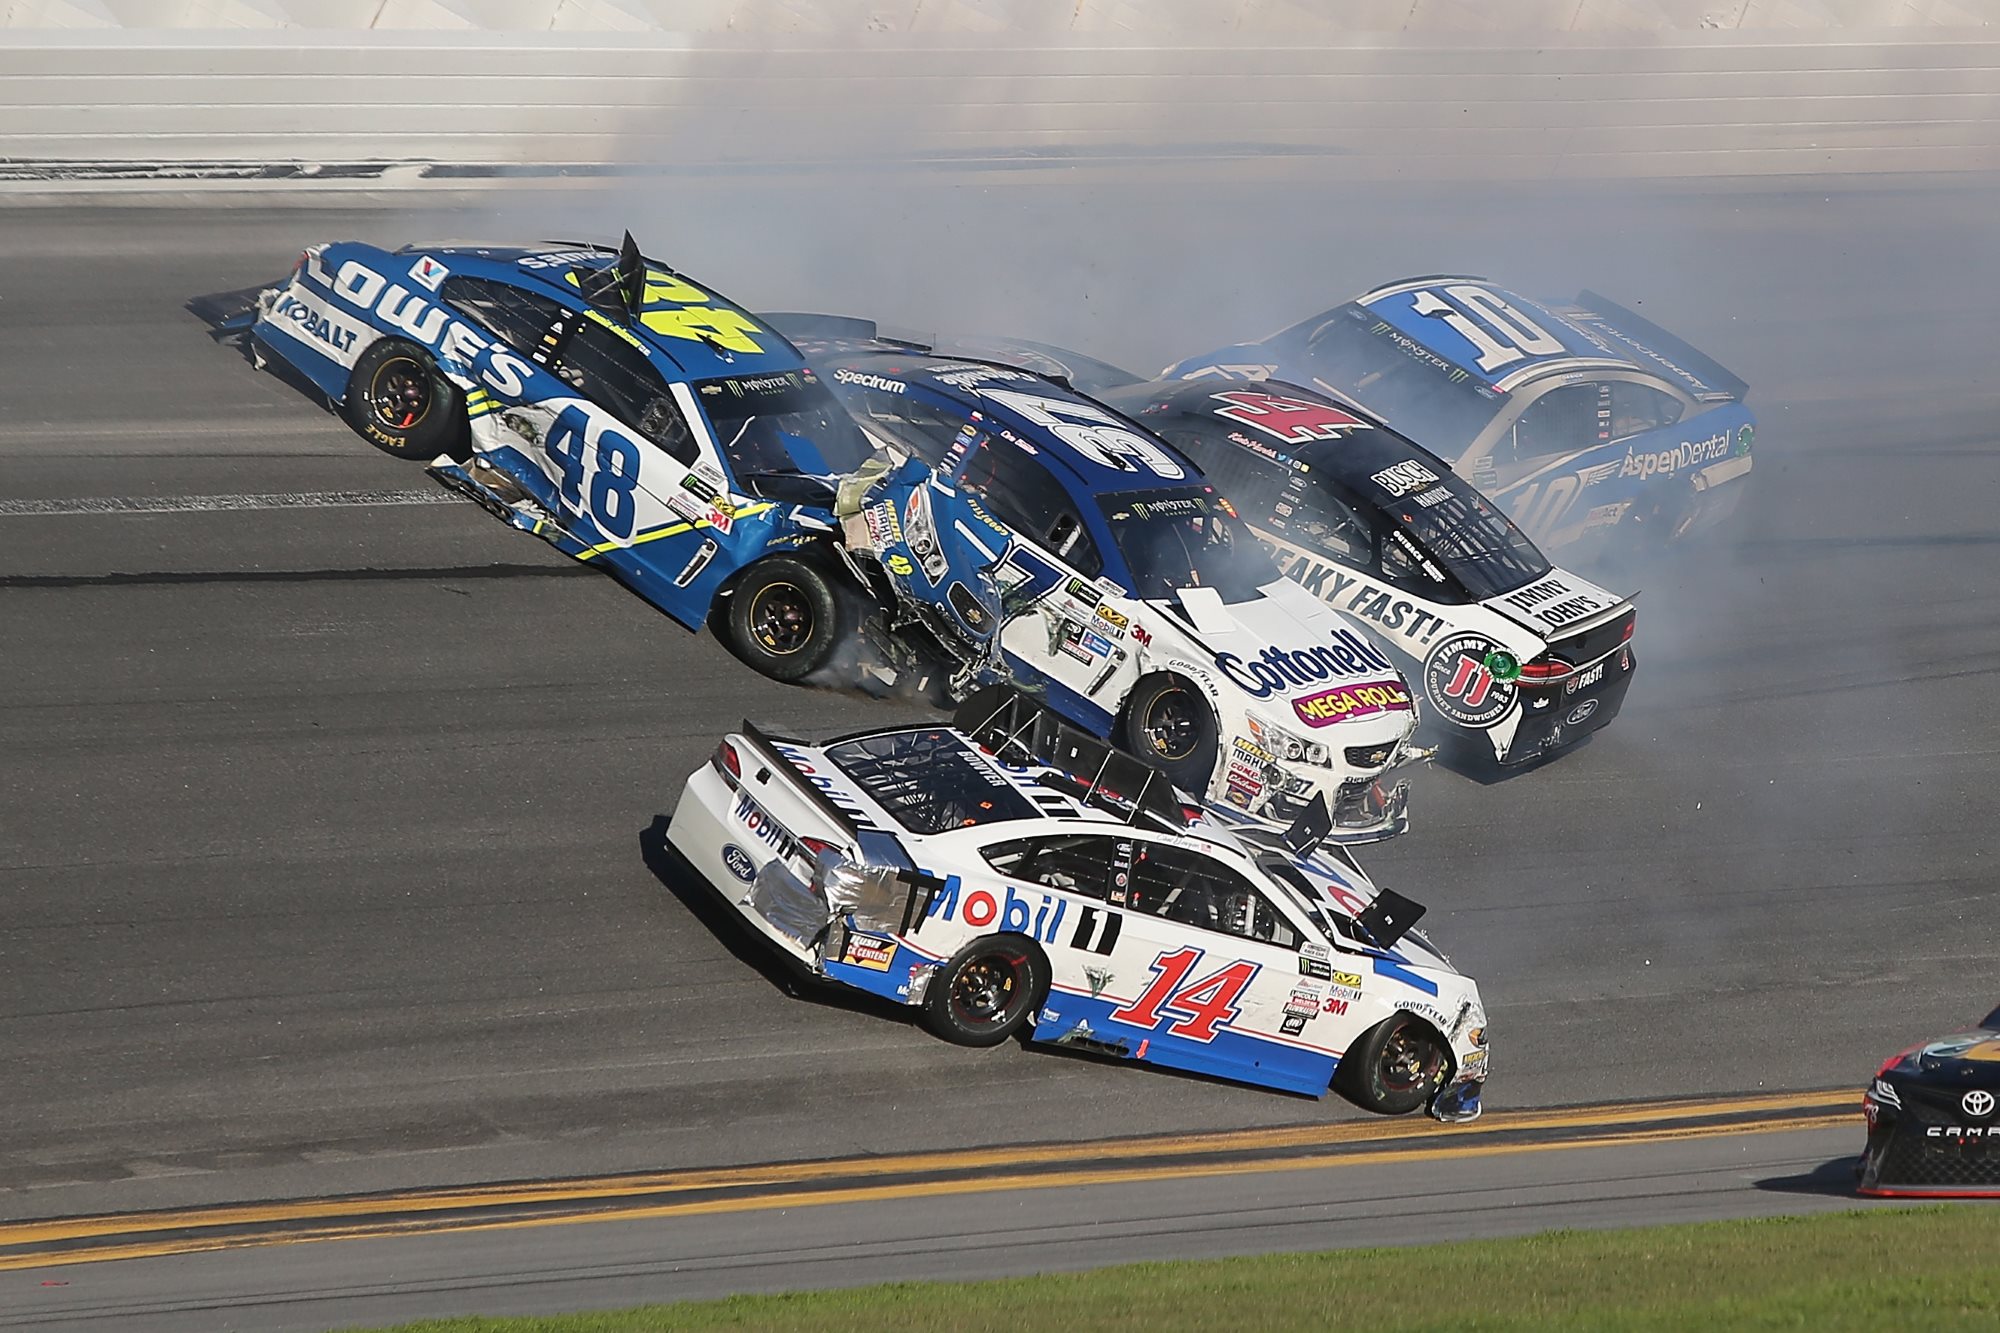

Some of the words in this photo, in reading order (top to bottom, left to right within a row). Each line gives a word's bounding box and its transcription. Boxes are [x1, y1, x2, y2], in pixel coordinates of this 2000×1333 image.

[275, 295, 358, 354] KOBALT
[307, 243, 534, 398] LOWE'S
[1409, 284, 1566, 372] 10
[1389, 332, 1450, 371] MONSTER
[741, 375, 791, 392] MONSTER
[833, 367, 907, 395] Spectrum
[1209, 390, 1375, 444] 4
[364, 423, 406, 447] EAGLE
[544, 404, 641, 539] 48
[1371, 460, 1440, 497] BUSCH
[1148, 497, 1197, 513] MONSTER
[1412, 486, 1454, 508] HARVICK
[705, 507, 730, 531] 3M
[873, 503, 896, 549] MAHLE
[884, 499, 903, 543] MOOG
[1393, 530, 1424, 562] OUTBACK
[888, 554, 914, 575] 48
[1504, 578, 1571, 614] JIMMY
[1533, 594, 1603, 626] JOHN'S
[1346, 585, 1445, 646] FAST!
[1130, 624, 1153, 648] 3M
[1438, 639, 1487, 664] JIMMY
[1168, 659, 1219, 697] GOODYEAR
[1215, 629, 1393, 698] Cottonell
[1432, 660, 1451, 676] Since
[1578, 663, 1604, 690] FAST!
[1430, 671, 1451, 712] GOURMET
[1443, 654, 1494, 707] JJ
[1299, 691, 1362, 722] MEGA
[1450, 703, 1504, 722] SANDWICHES
[1490, 690, 1509, 704] 1983
[1233, 748, 1267, 771] MAHL
[1235, 738, 1276, 763] MOOG
[775, 745, 856, 810] Mobil
[956, 750, 1008, 787] BOWYER
[1230, 762, 1259, 779] COMP
[734, 795, 781, 849] Mobil
[725, 850, 753, 879] Ford
[919, 868, 1067, 944] Mobil
[850, 934, 882, 949] RUSH
[857, 947, 889, 962] CENTERS
[1108, 944, 1264, 1044] 14
[1330, 984, 1353, 998] Mobil
[1322, 998, 1349, 1017] 3M
[1394, 1000, 1447, 1026] GOODYEAR
